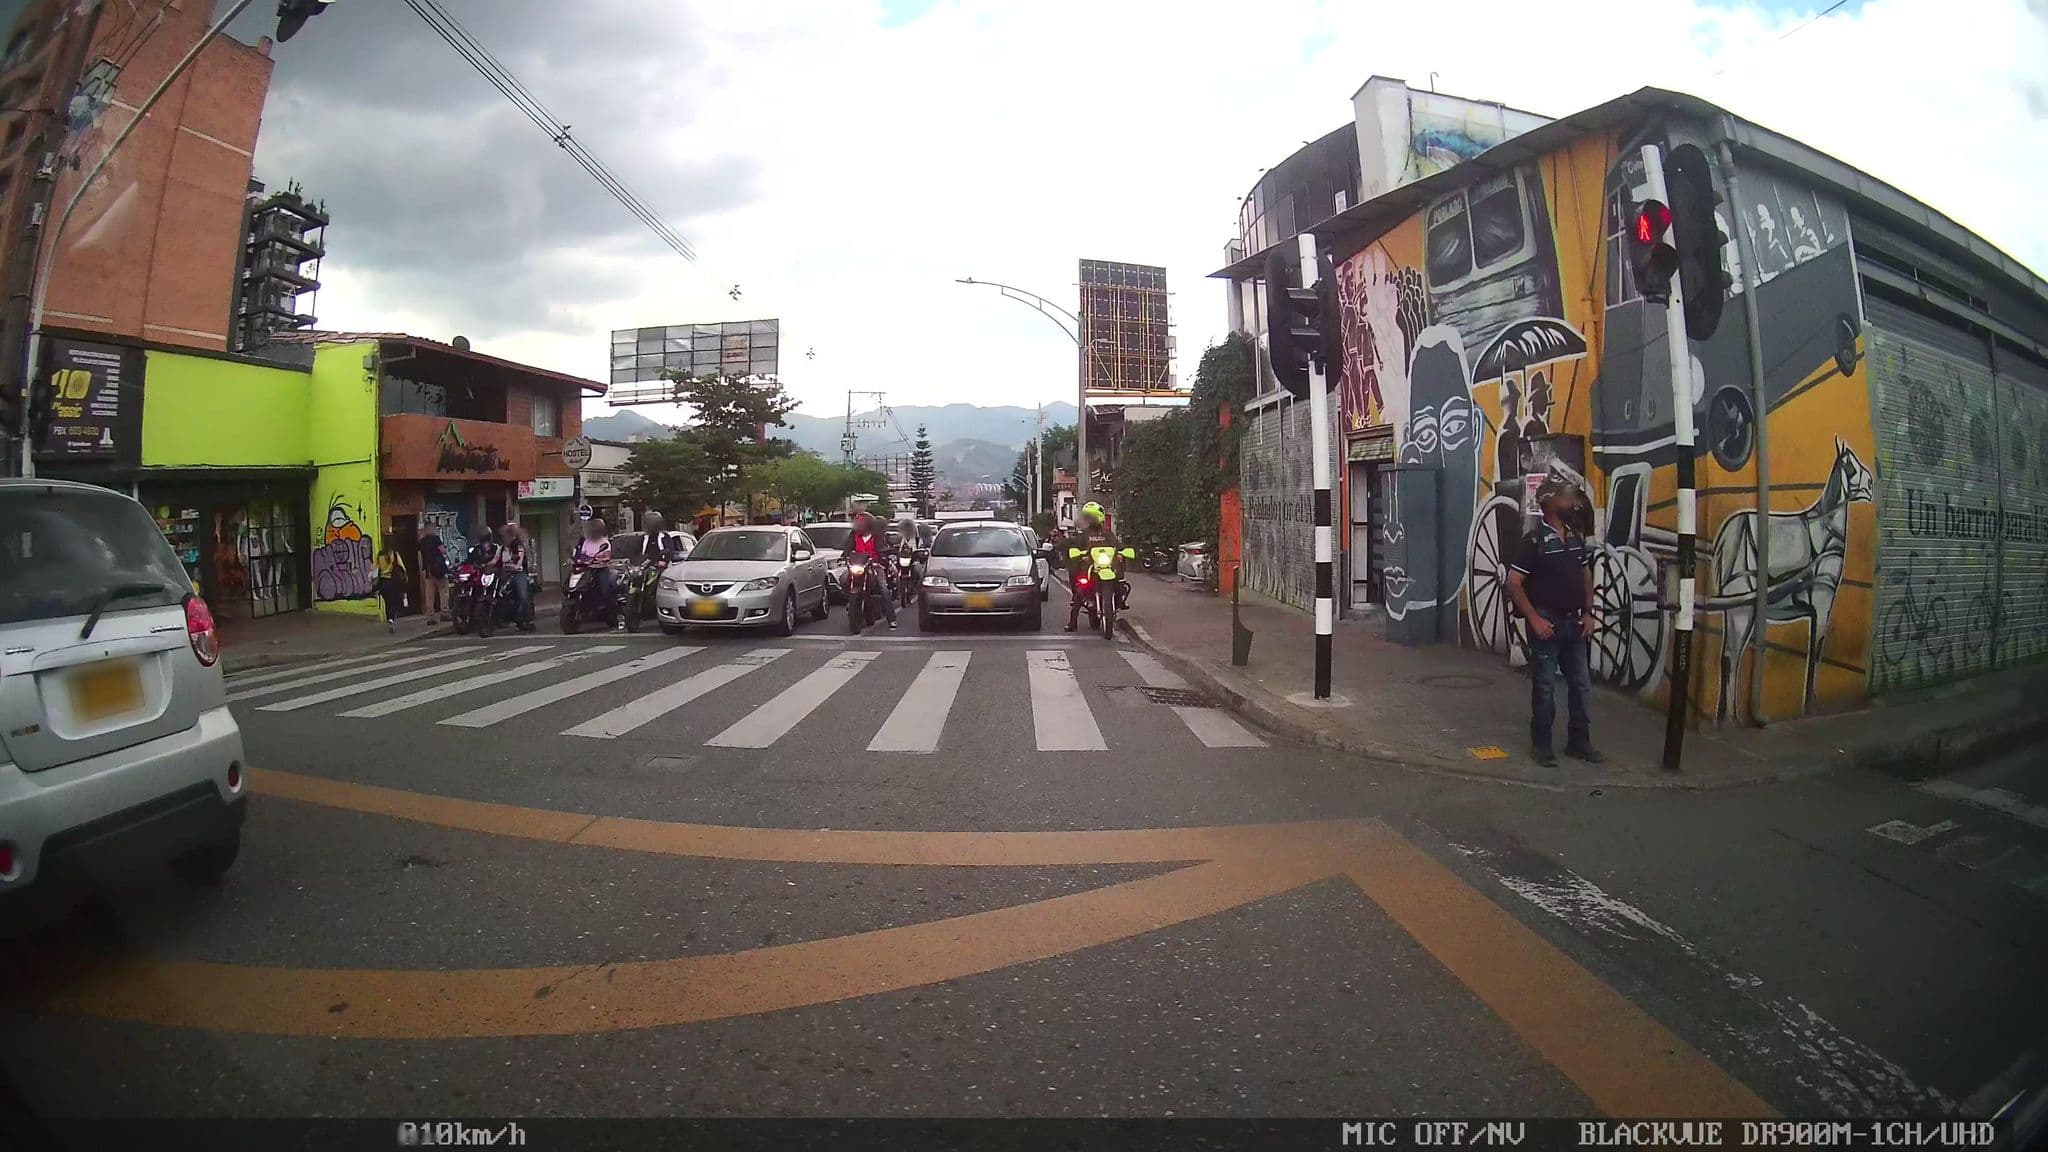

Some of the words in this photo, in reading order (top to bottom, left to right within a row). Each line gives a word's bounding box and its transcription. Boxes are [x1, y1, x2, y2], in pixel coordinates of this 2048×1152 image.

[563, 449, 590, 457] HOSTEL
[1906, 488, 1938, 536] Un
[1943, 492, 1998, 540] barrio
